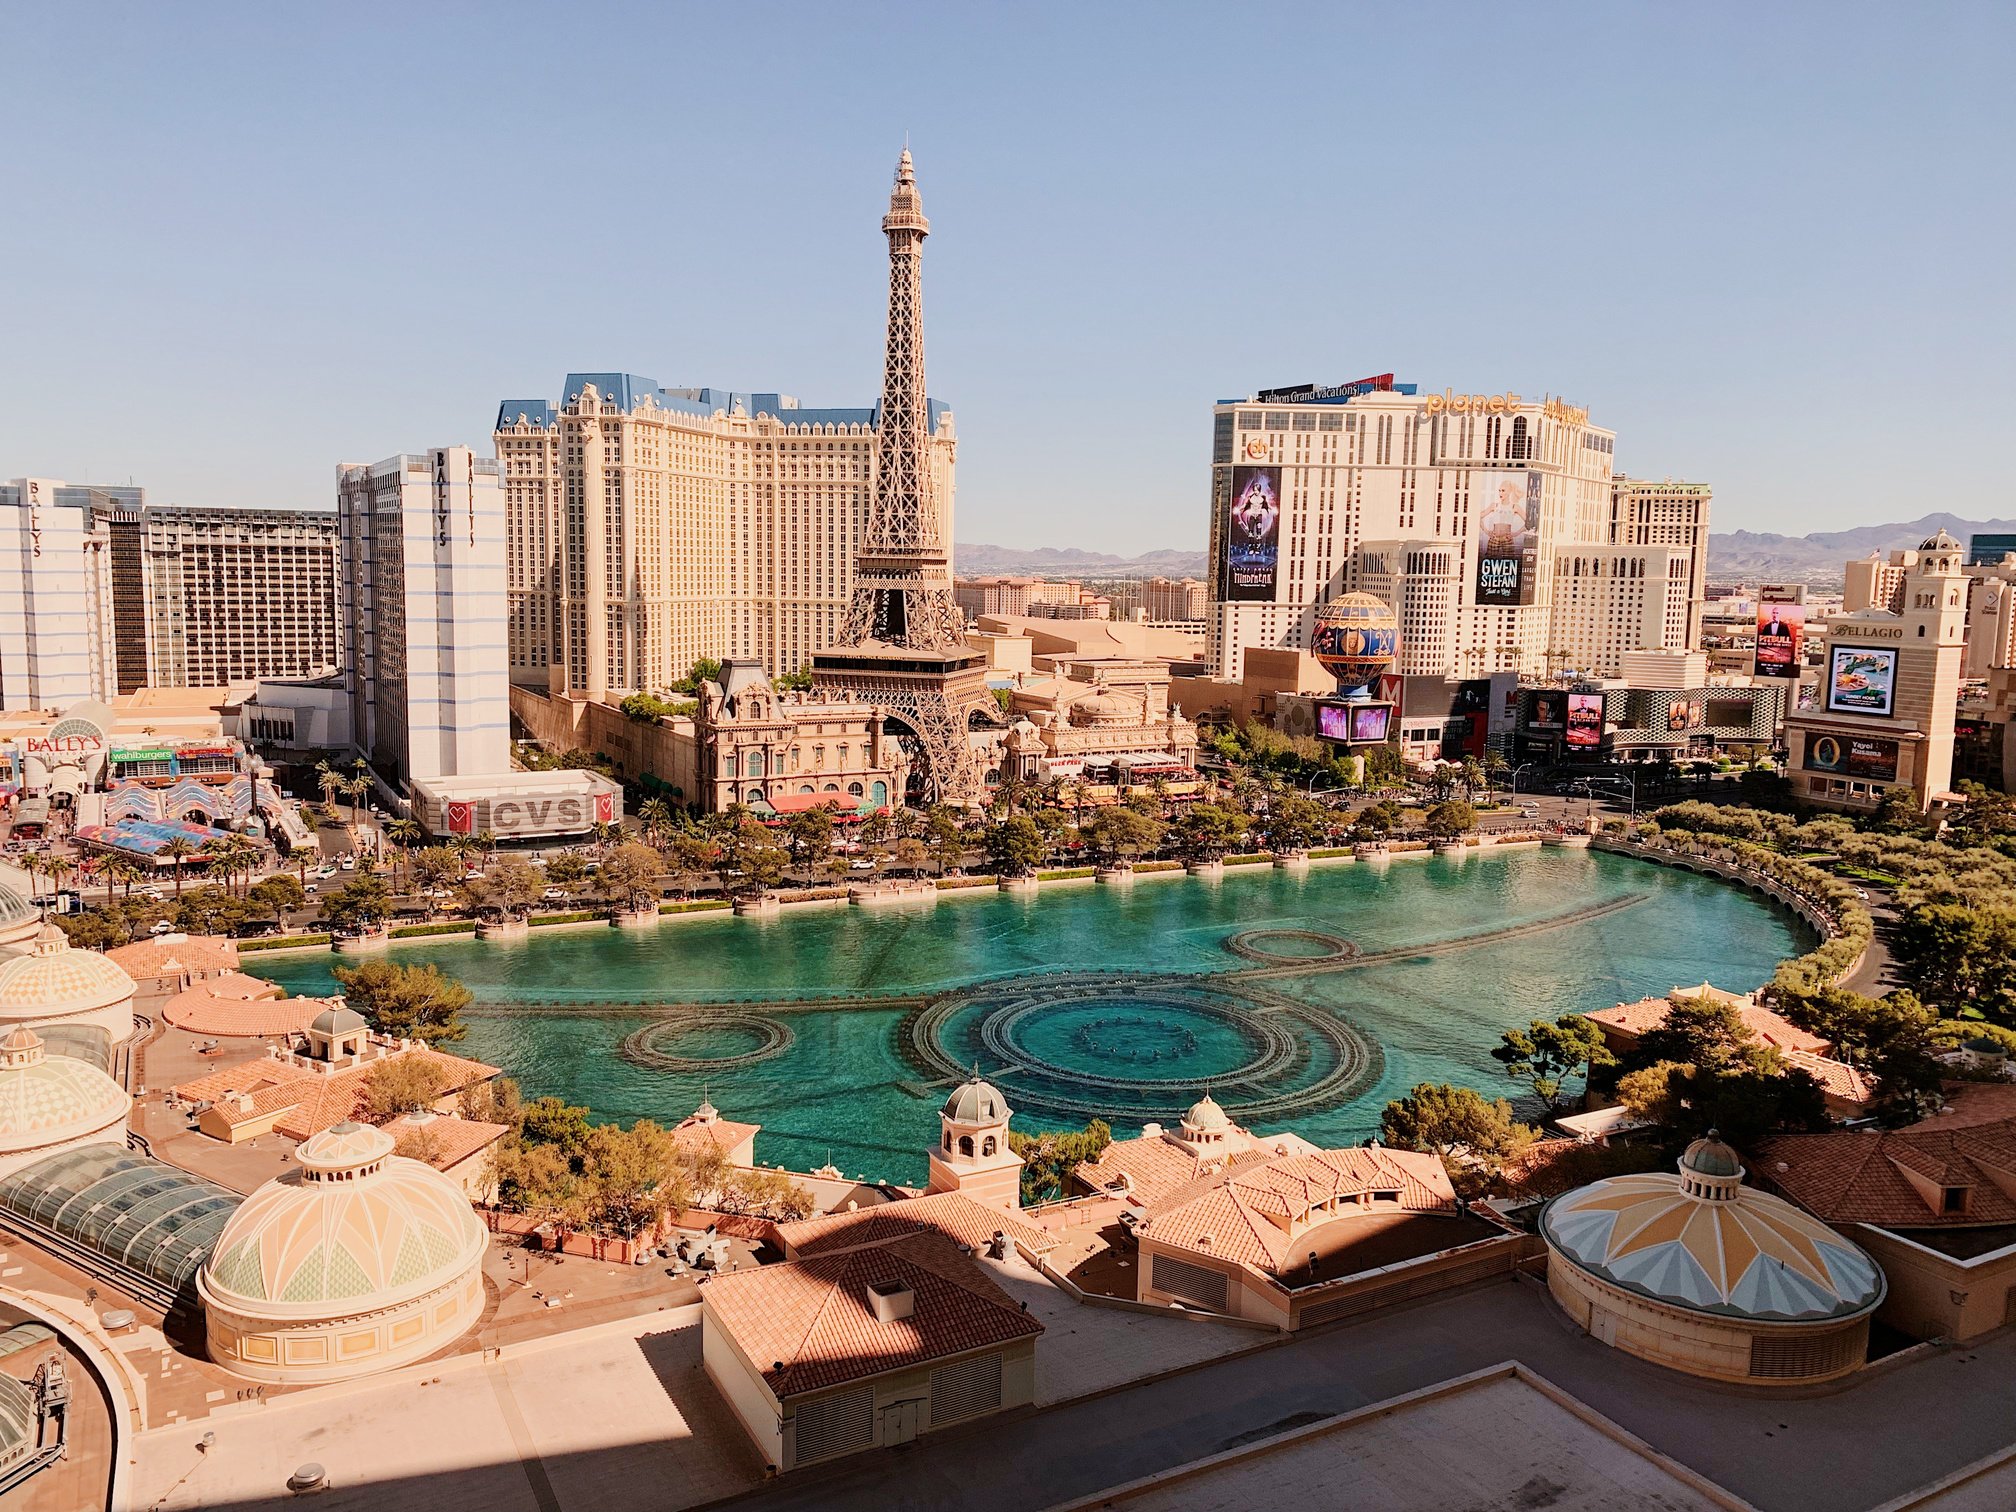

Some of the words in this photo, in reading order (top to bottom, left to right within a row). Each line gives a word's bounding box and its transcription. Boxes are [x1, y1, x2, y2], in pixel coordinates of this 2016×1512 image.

[1265, 393, 1289, 403] Hilton
[1290, 390, 1315, 402] Grand
[1316, 385, 1356, 399] Vacations
[1427, 387, 1521, 417] planet
[1481, 559, 1517, 575] GWEN
[1481, 574, 1517, 588] STEFANI
[1759, 635, 1792, 643] PITBULL
[1831, 625, 1903, 638] BELLAGIO
[1381, 679, 1400, 707] M
[113, 750, 172, 760] wahlburgers
[493, 799, 581, 829] CVS
